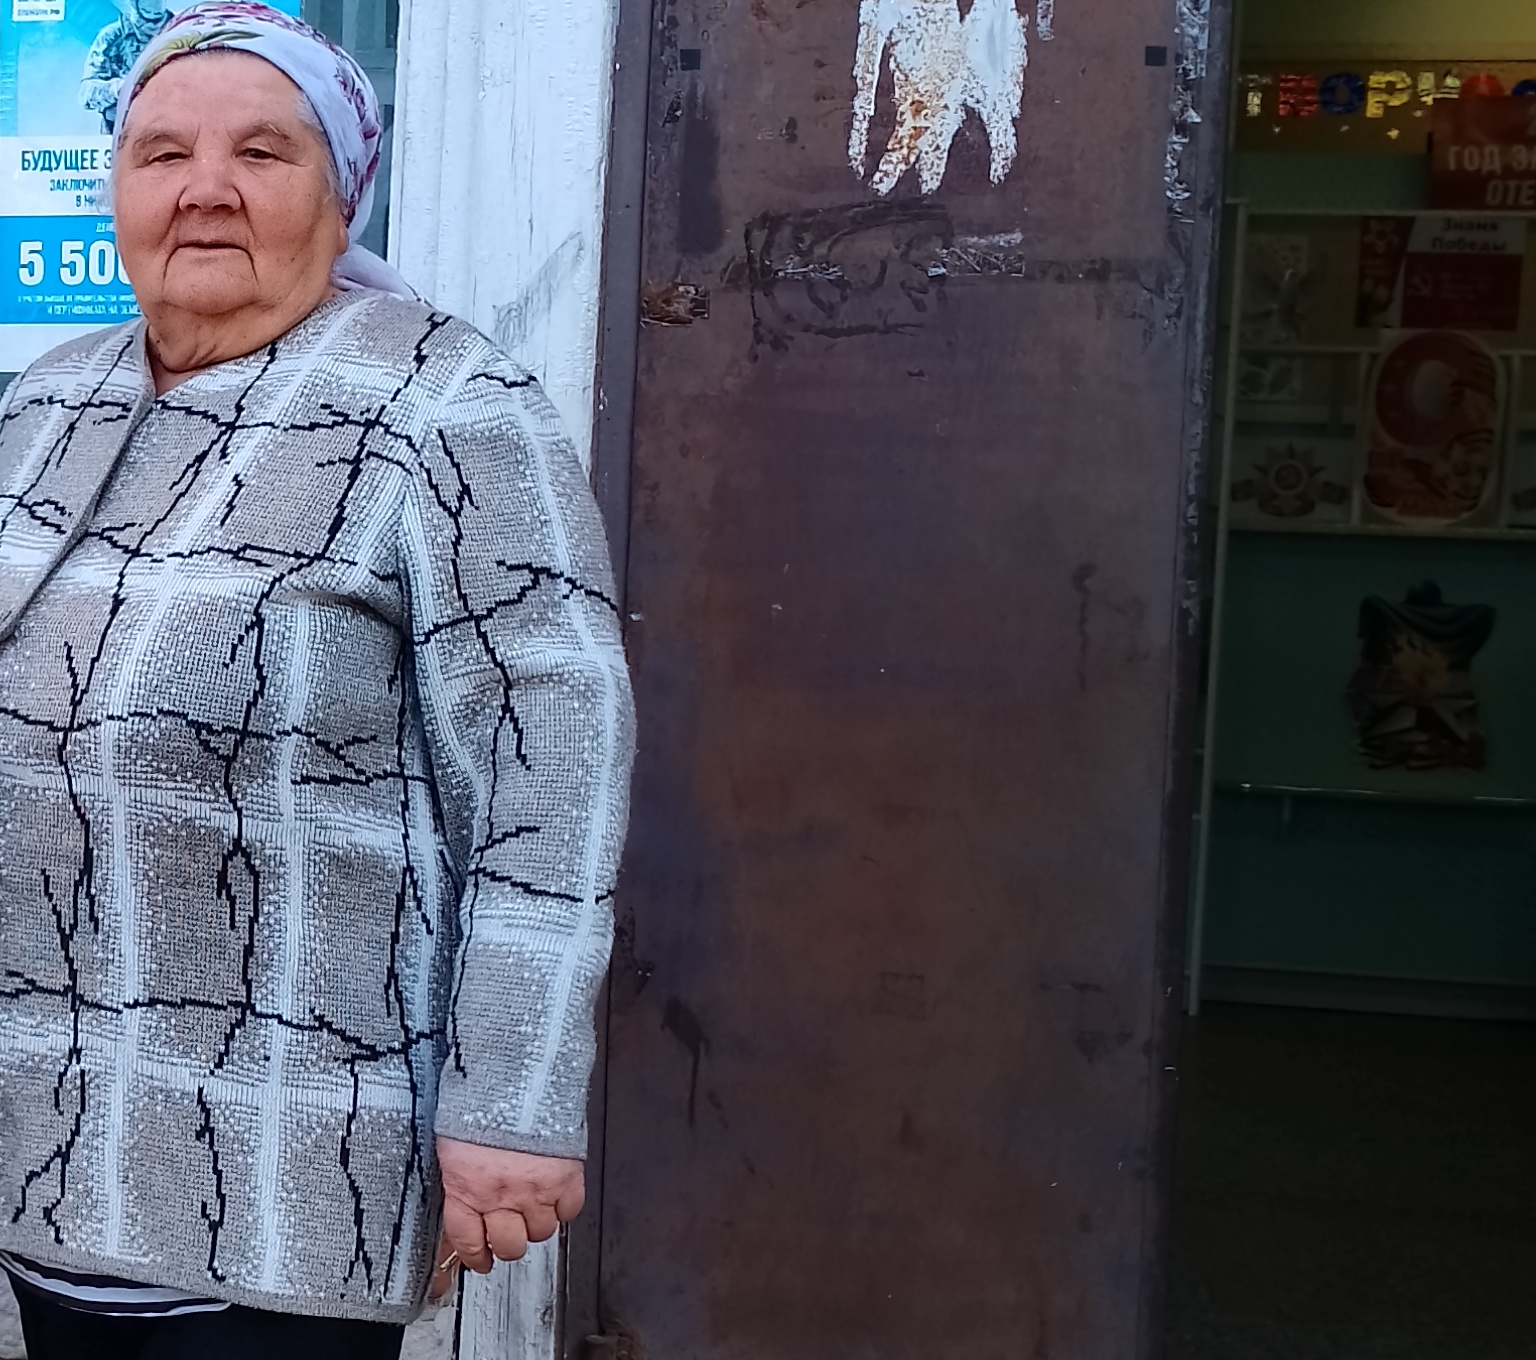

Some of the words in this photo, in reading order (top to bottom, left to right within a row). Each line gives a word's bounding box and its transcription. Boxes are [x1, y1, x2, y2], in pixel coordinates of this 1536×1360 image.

[21, 148, 100, 172] БУДУЩЕЕ
[1449, 144, 1501, 176] ГОД
[1442, 218, 1498, 232] Знамя
[1432, 237, 1507, 252] Победы
[19, 241, 45, 286] 5
